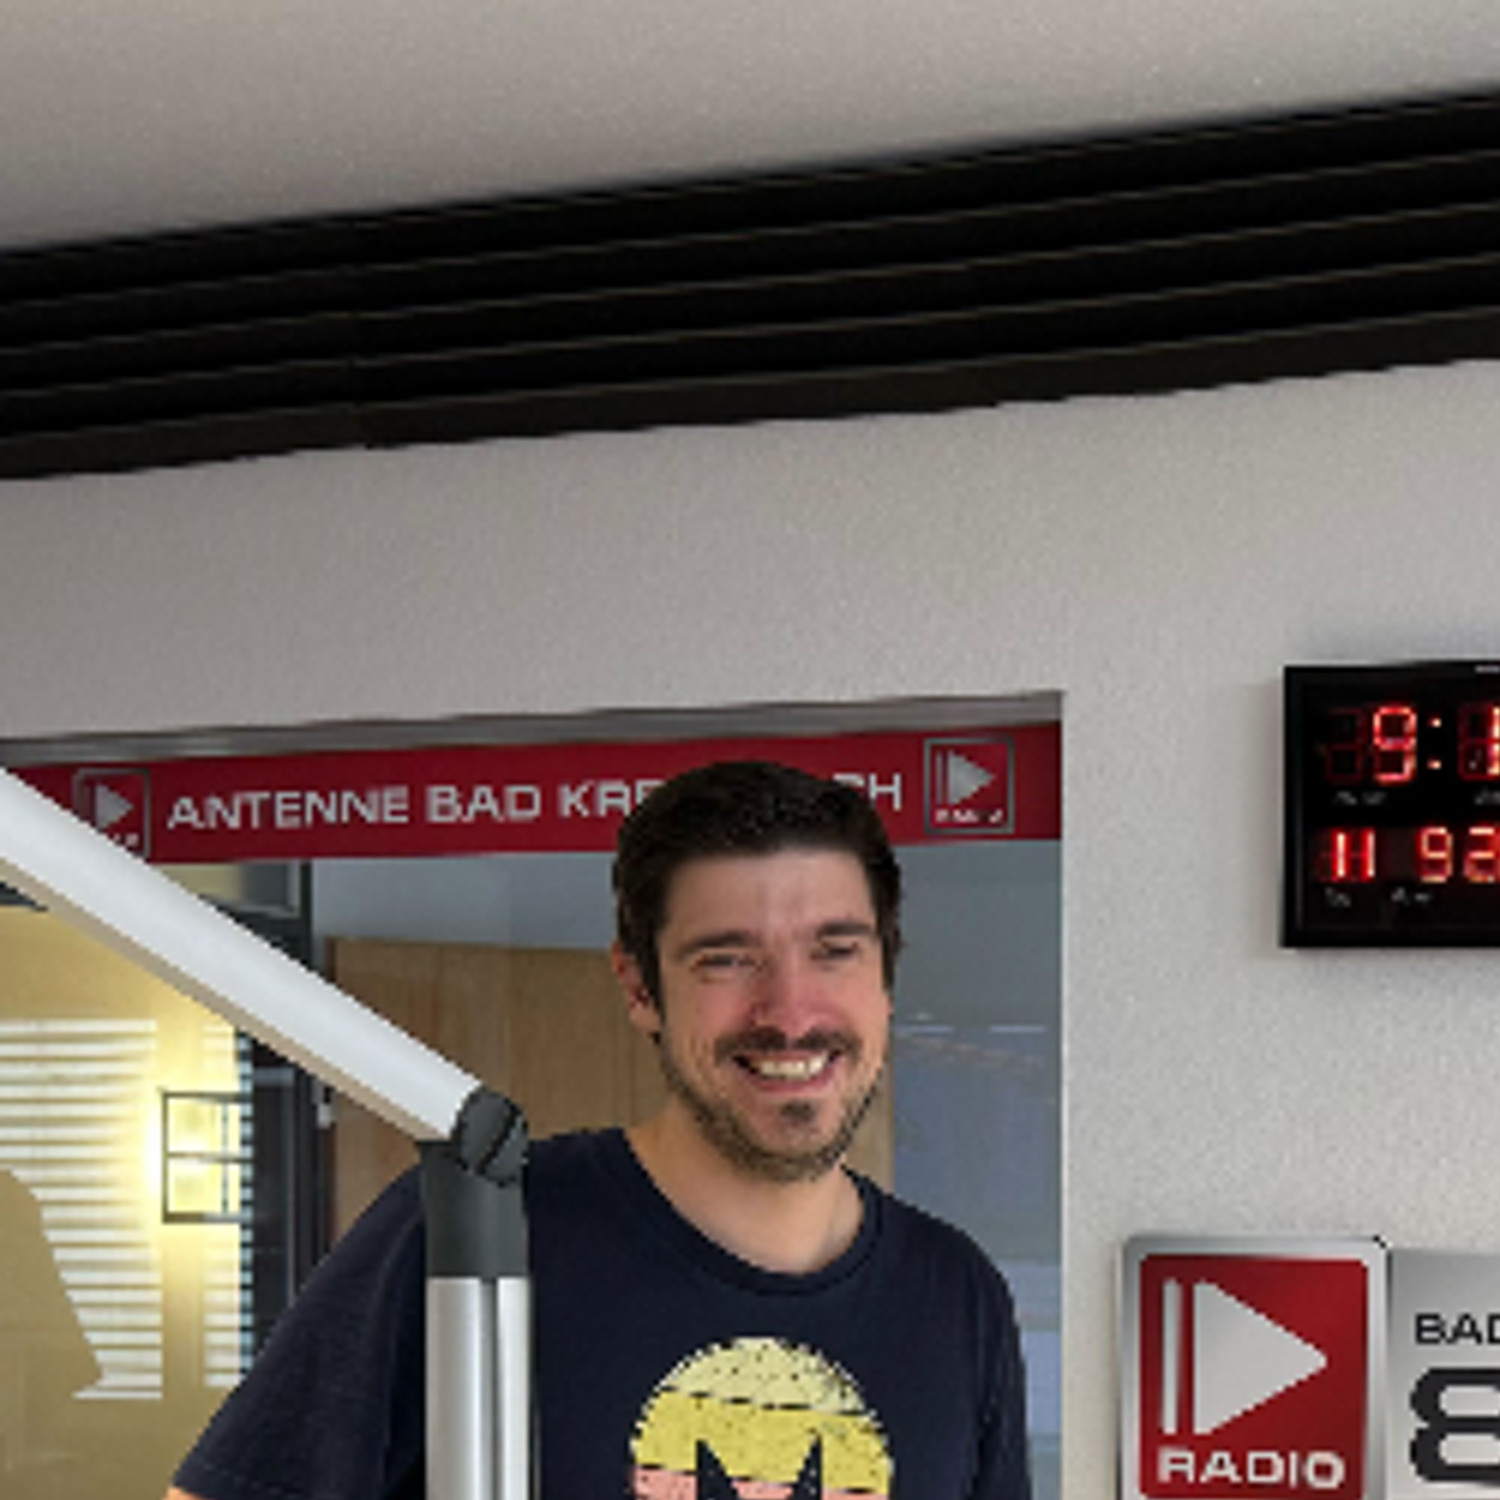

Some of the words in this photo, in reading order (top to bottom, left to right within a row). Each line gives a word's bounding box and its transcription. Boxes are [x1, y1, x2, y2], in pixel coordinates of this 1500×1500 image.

[167, 785, 409, 830] ANTENNE
[425, 785, 541, 823] BAD
[1156, 1448, 1346, 1489] RADIO
